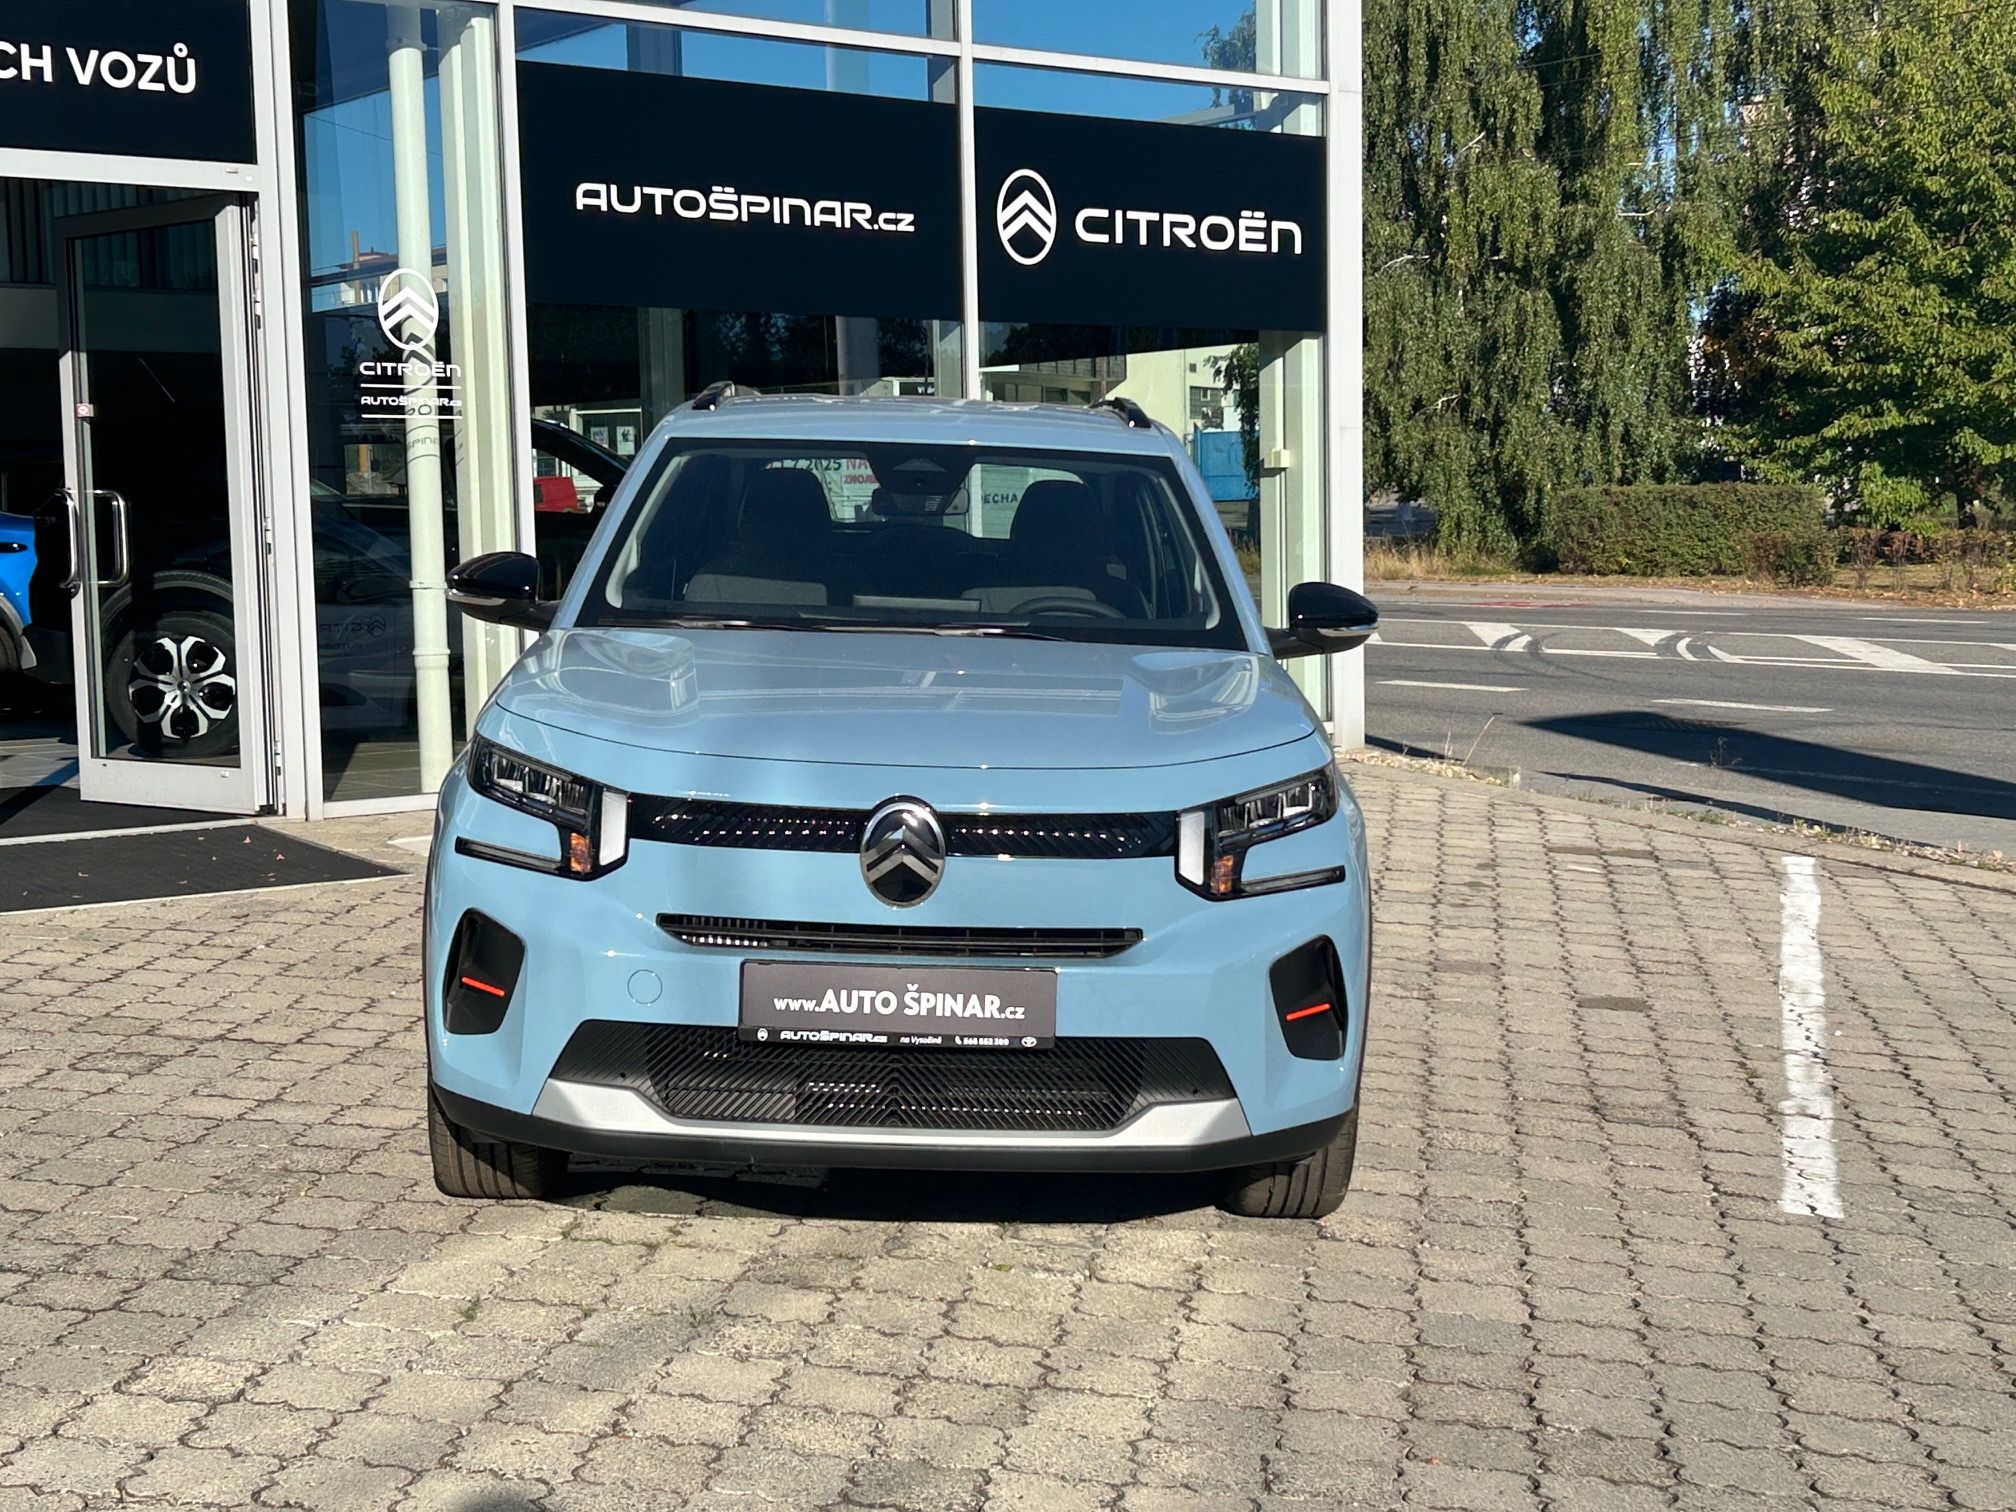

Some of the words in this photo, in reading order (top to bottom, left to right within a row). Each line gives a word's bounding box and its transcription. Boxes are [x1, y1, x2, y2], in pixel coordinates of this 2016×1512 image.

[65, 42, 197, 94] VOZŮ
[1074, 207, 1302, 255] CITROËN
[359, 361, 462, 378] CITROËN
[981, 492, 1019, 504] ECHA
[773, 988, 898, 1015] www.AUTO
[903, 984, 1025, 1019] ŠPINAR.cz
